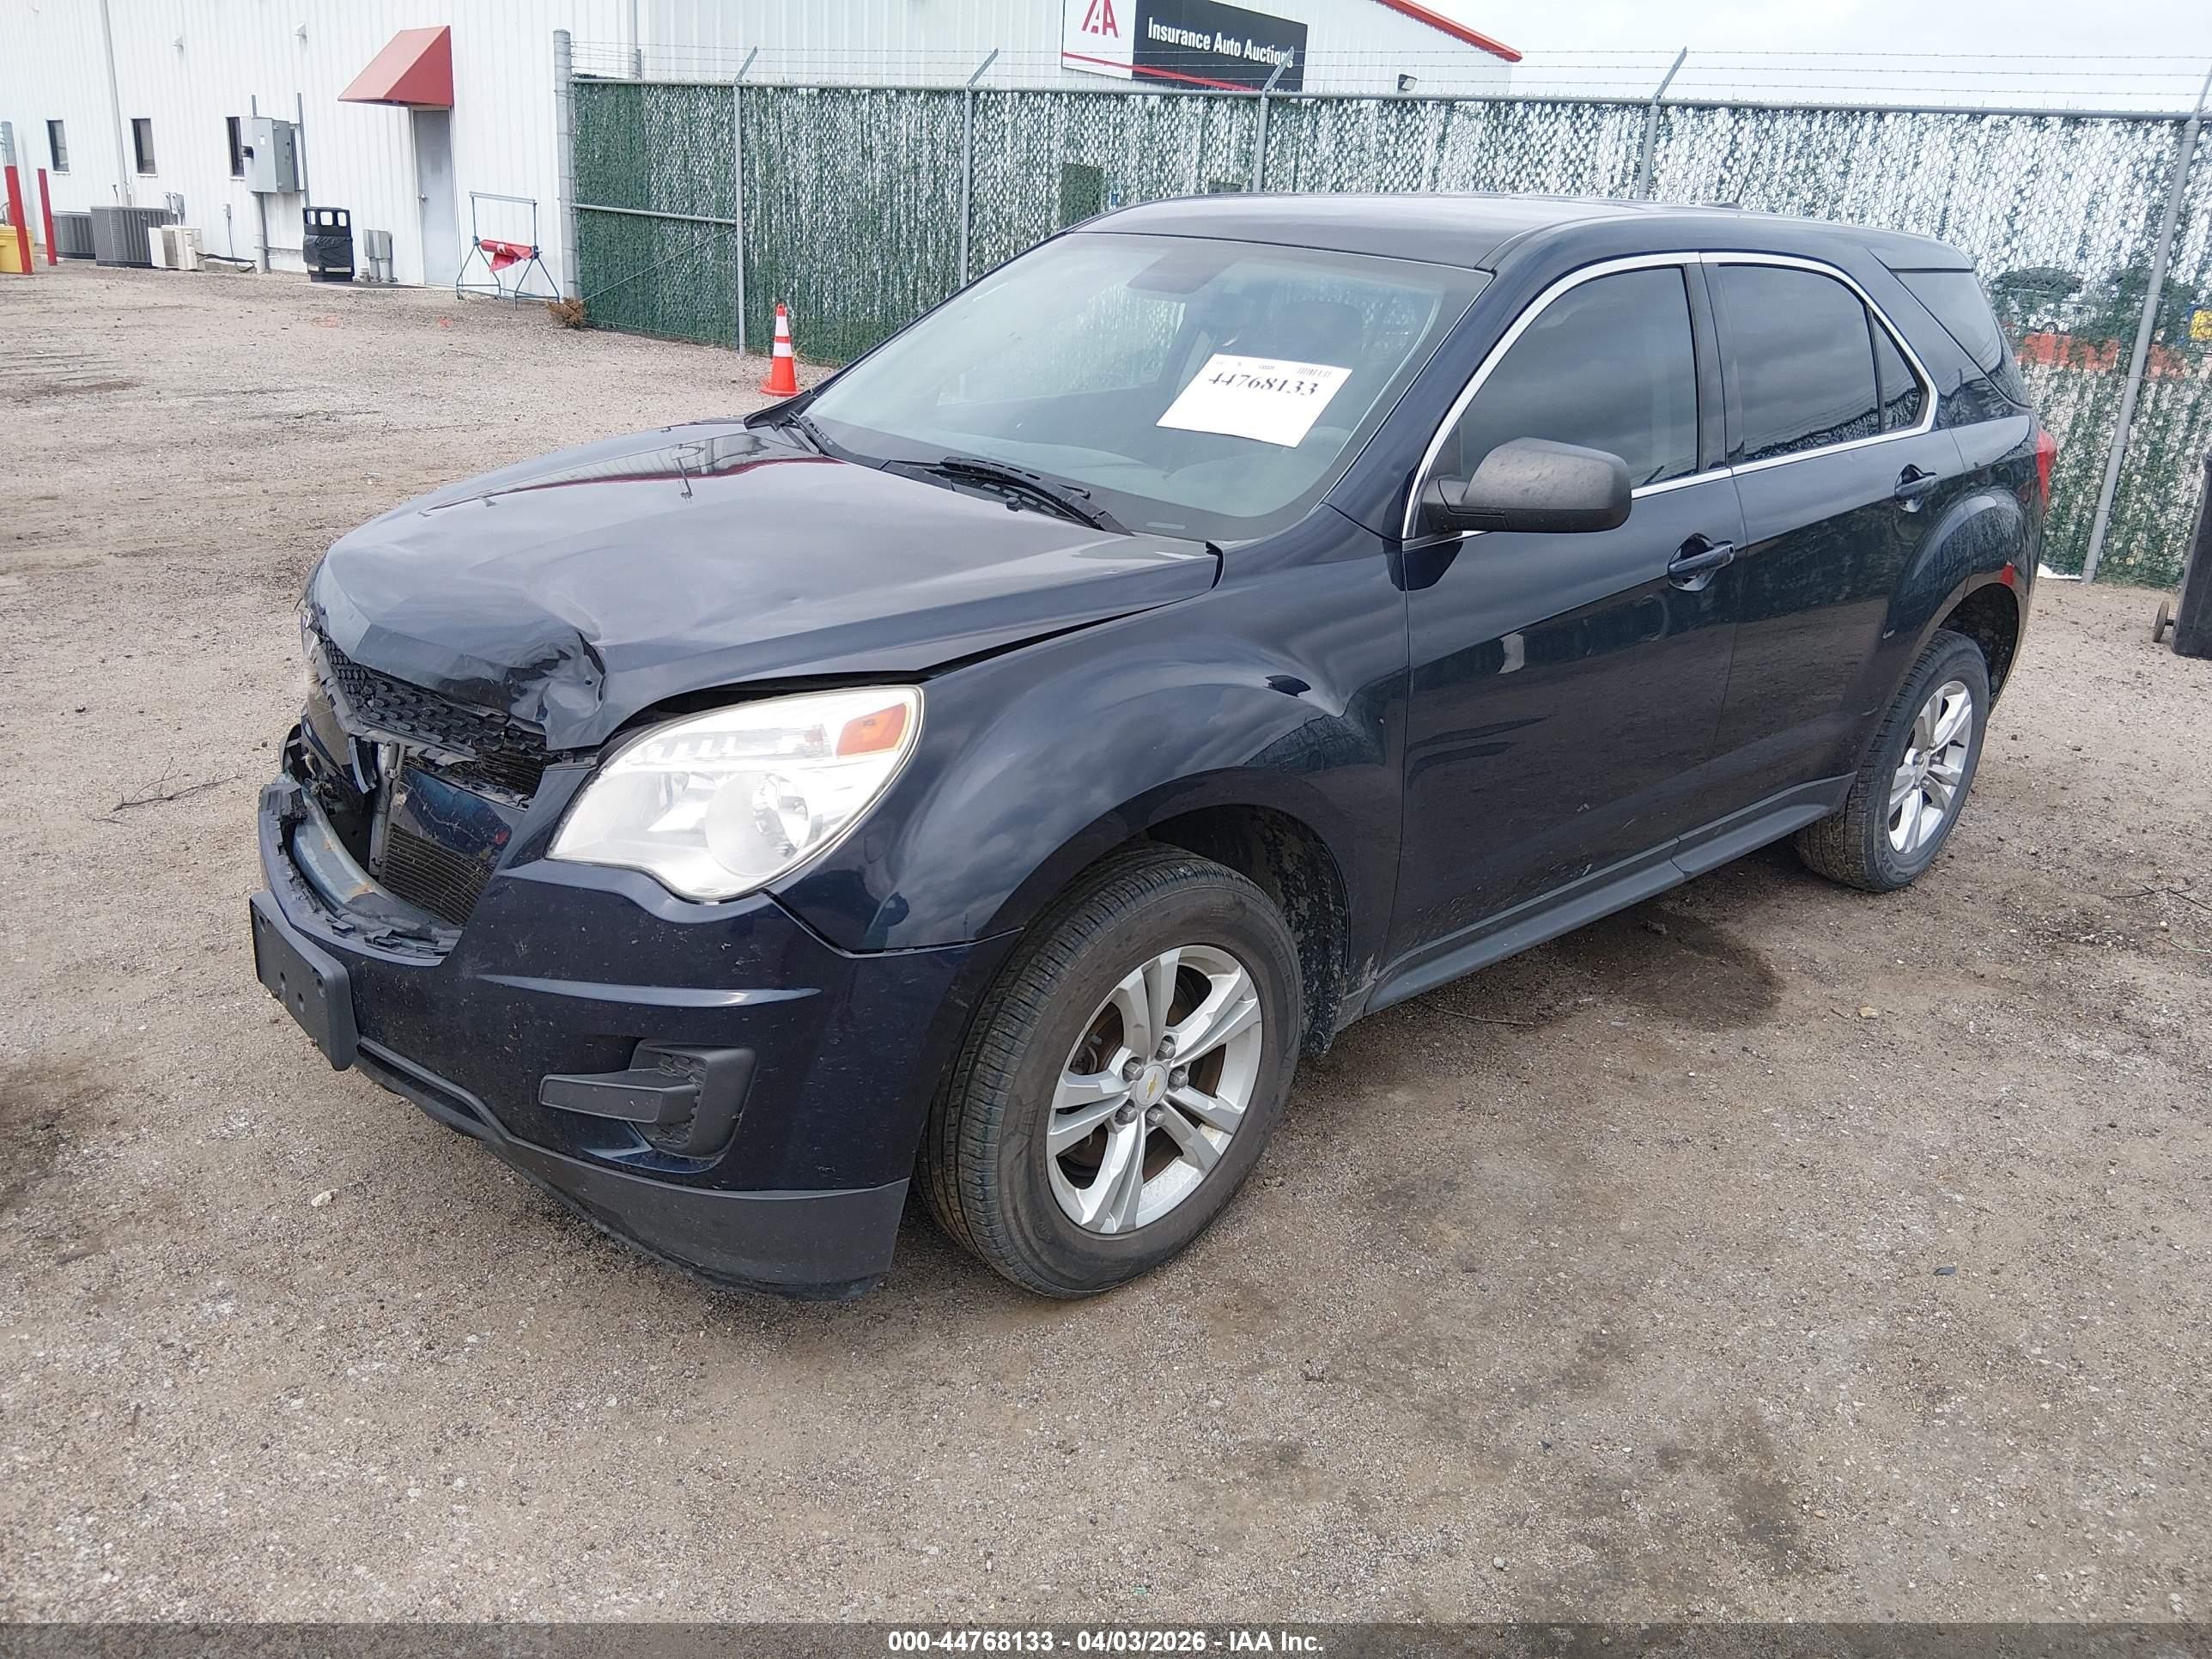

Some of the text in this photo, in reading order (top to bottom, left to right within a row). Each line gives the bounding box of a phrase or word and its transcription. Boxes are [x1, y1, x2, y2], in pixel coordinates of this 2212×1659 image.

[1148, 16, 1211, 51] Insurance
[1212, 32, 1242, 58] Auto
[1208, 372, 1318, 395] 44768133
